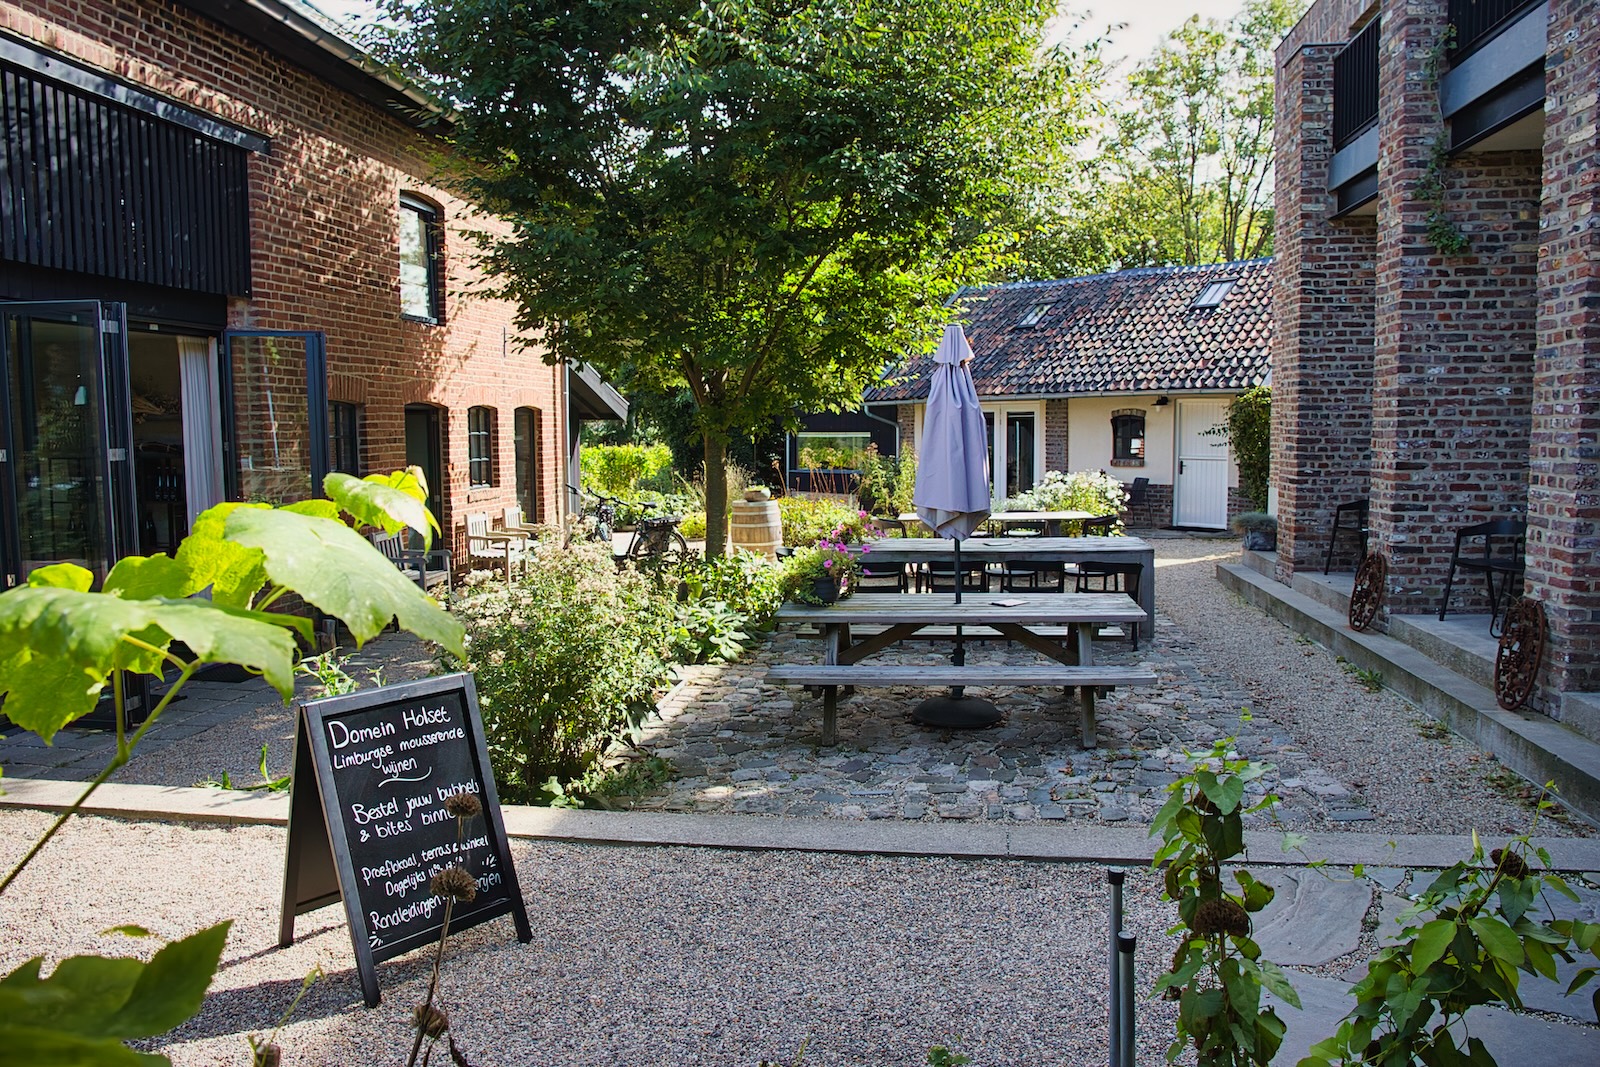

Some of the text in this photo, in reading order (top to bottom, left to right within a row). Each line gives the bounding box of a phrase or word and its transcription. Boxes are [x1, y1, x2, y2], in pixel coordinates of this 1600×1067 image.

[328, 706, 451, 749] Domein Holset
[333, 727, 465, 769] Limburgse mousserende
[382, 758, 418, 778] wijnen
[352, 797, 399, 825] Bestel
[405, 794, 432, 818] jouw
[359, 829, 371, 843] &
[375, 819, 412, 838] bites
[361, 853, 421, 886] Proeflokaal,
[421, 843, 452, 862] terras
[460, 835, 489, 851] winkel
[385, 870, 427, 898] Dagelijks
[370, 894, 441, 931] Rondleidingen
